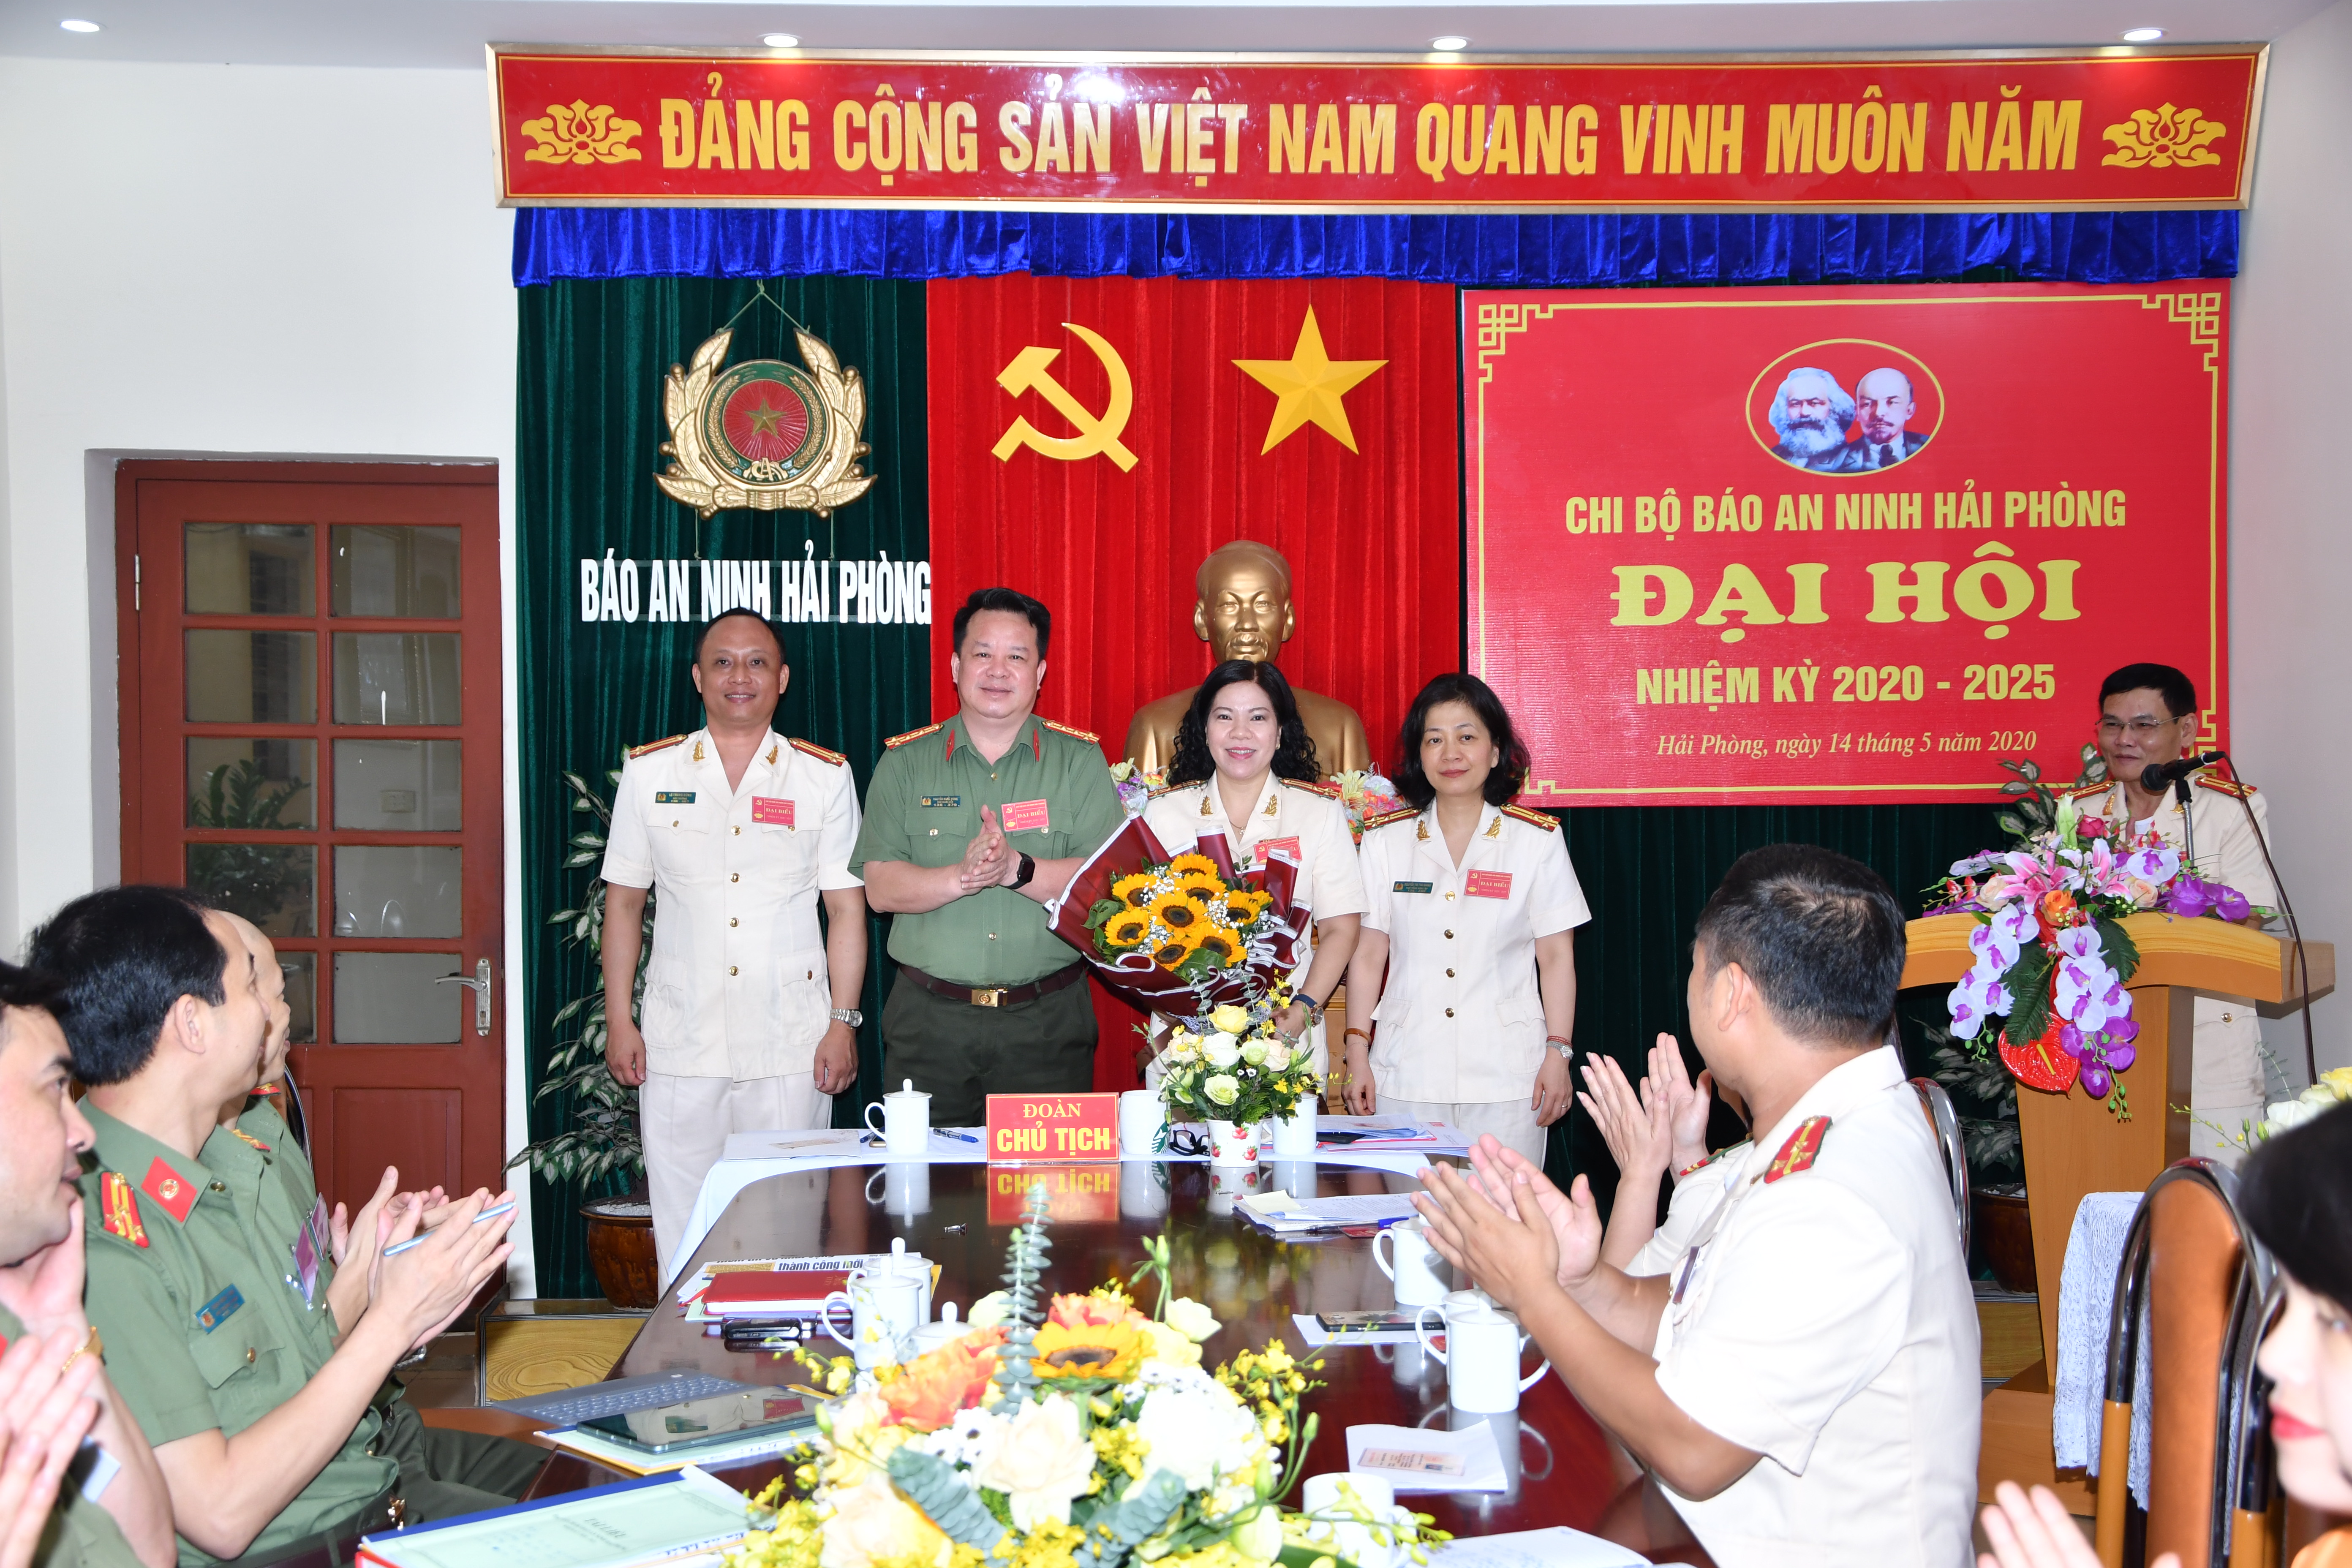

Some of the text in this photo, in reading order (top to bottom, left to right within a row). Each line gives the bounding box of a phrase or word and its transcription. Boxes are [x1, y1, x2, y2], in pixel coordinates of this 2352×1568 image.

[659, 71, 2082, 187] ĐẢNG CỘNG SẢN VIỆT NAM QUANG VINH MUÔN NĂM
[1565, 479, 2126, 541] CHI BỘ BÁO AN NINH HẢI PHÒNG
[581, 539, 932, 625] BÁO AN NINH HẢI PHÒNG
[1610, 540, 2081, 643] ĐẠI HỘI
[1637, 659, 1759, 712] NHIỆM
[1773, 658, 1821, 702] KỲ
[1832, 665, 1924, 702] 2020
[1963, 664, 2055, 700] 2025
[1656, 731, 2037, 759] Hải Phòng, ngày 14 tháng 5 năm 2020
[1023, 1099, 1081, 1118] ĐOÀN
[997, 1120, 1110, 1156] CHỦ TỊCH
[778, 1261, 810, 1271] thành
[812, 1260, 840, 1270] công
